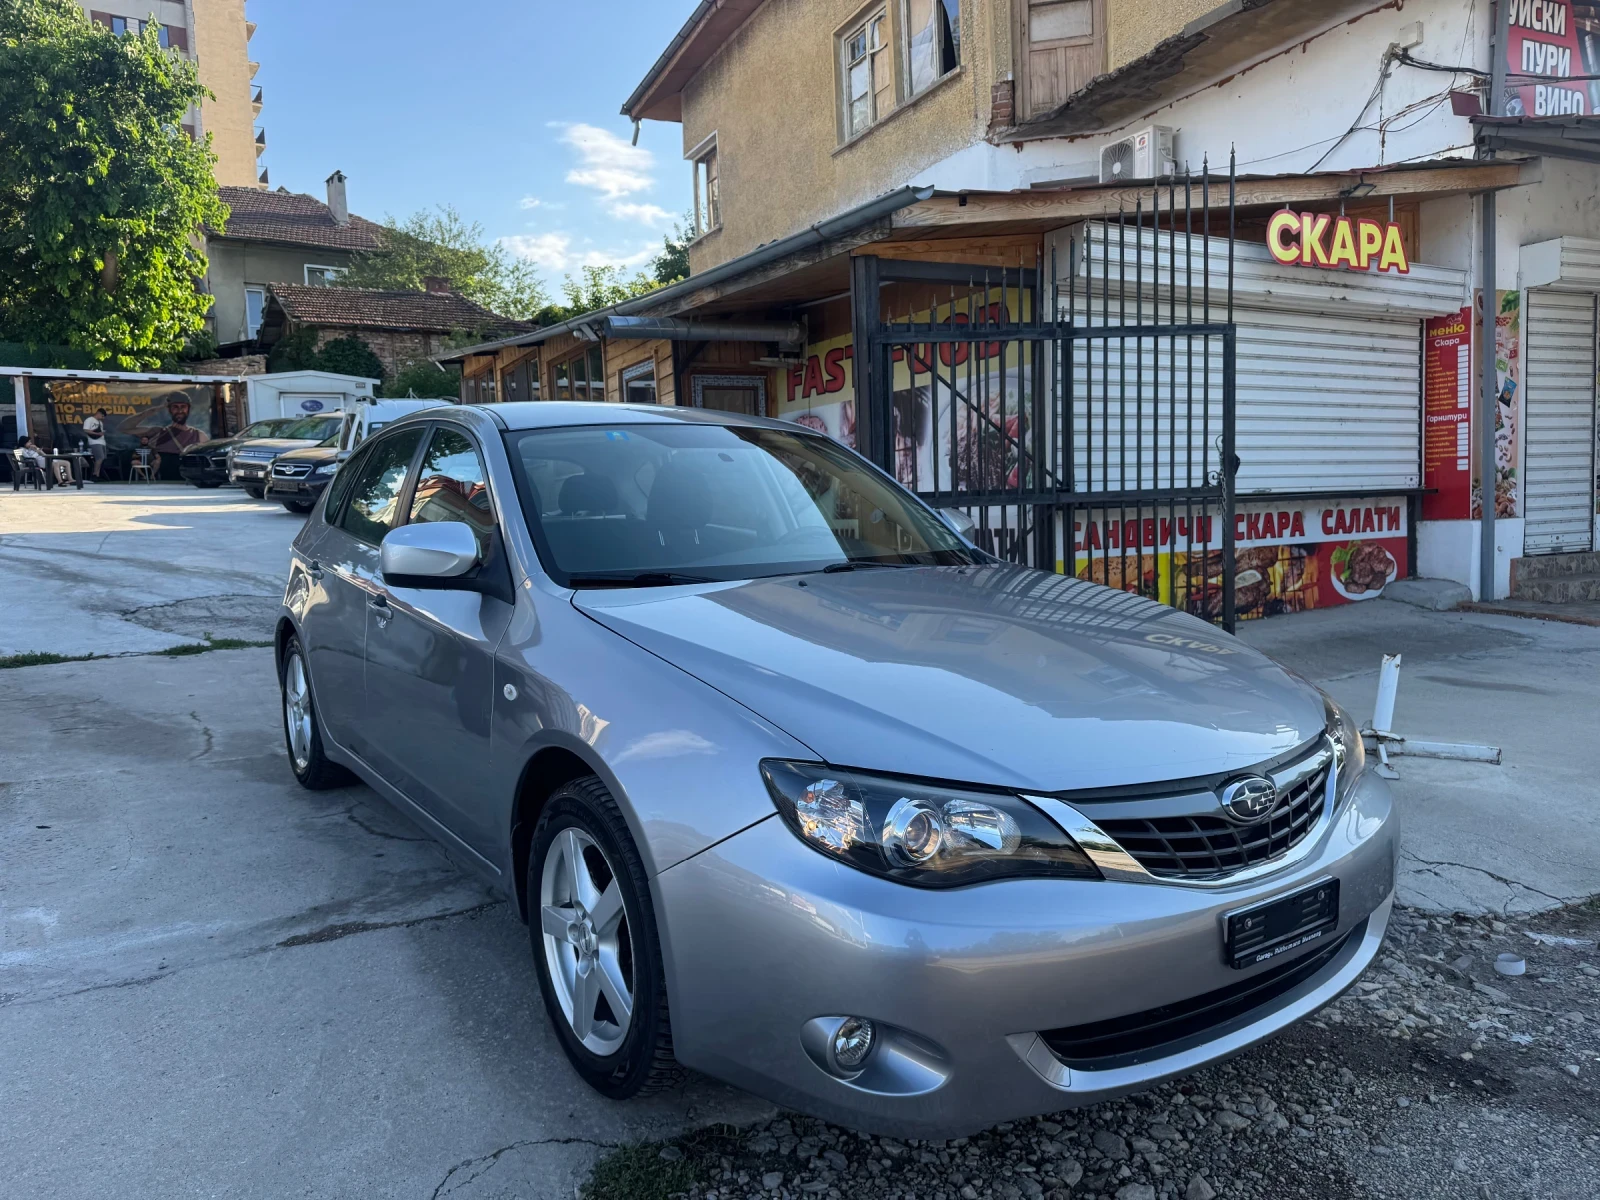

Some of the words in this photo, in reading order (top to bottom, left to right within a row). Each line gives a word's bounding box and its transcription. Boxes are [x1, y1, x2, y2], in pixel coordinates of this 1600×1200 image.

[1509, 0, 1566, 35] УИСКИ
[1522, 39, 1571, 77] ПУРИ
[1534, 85, 1584, 116] ВИНО
[1267, 210, 1409, 273] СКАРА
[131, 395, 152, 405] СИ
[1234, 511, 1305, 541] СКАРА
[1321, 505, 1401, 535] САЛАТИ
